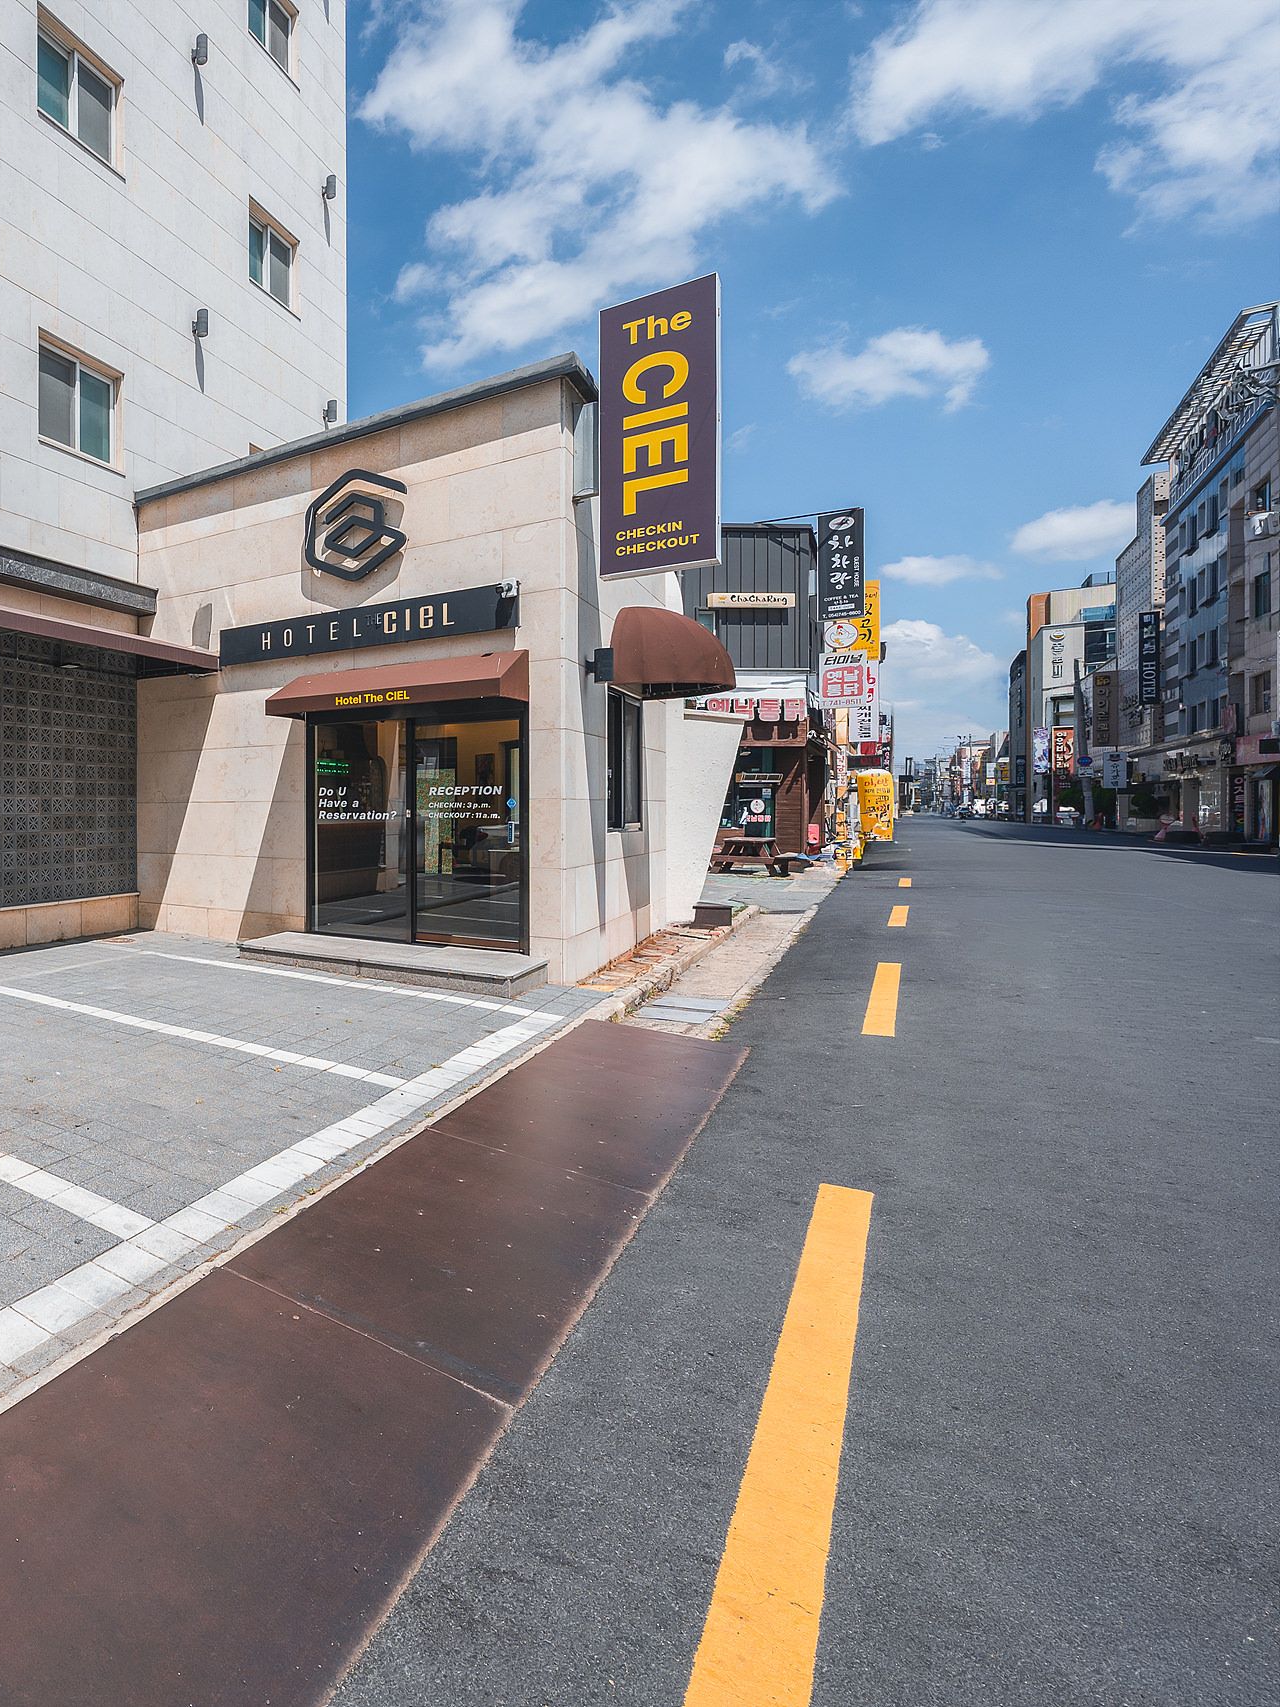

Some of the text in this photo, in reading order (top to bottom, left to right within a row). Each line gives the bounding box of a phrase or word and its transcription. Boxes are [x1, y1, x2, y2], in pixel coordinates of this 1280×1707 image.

[622, 310, 692, 345] The
[622, 350, 689, 516] CIEL
[615, 520, 682, 541] CHECKIN
[615, 533, 700, 557] CHECKOUT
[261, 618, 362, 651] HOTEL
[823, 653, 863, 666] 터미널
[826, 670, 860, 683] 옛날
[1142, 660, 1156, 702] HOTEL
[826, 683, 860, 697] 통닭
[335, 690, 410, 706] Hotel The CIEL
[318, 786, 347, 796] Do U
[428, 785, 503, 796] RECEPTION
[318, 798, 359, 808] Have a
[318, 810, 397, 820] Reservation?
